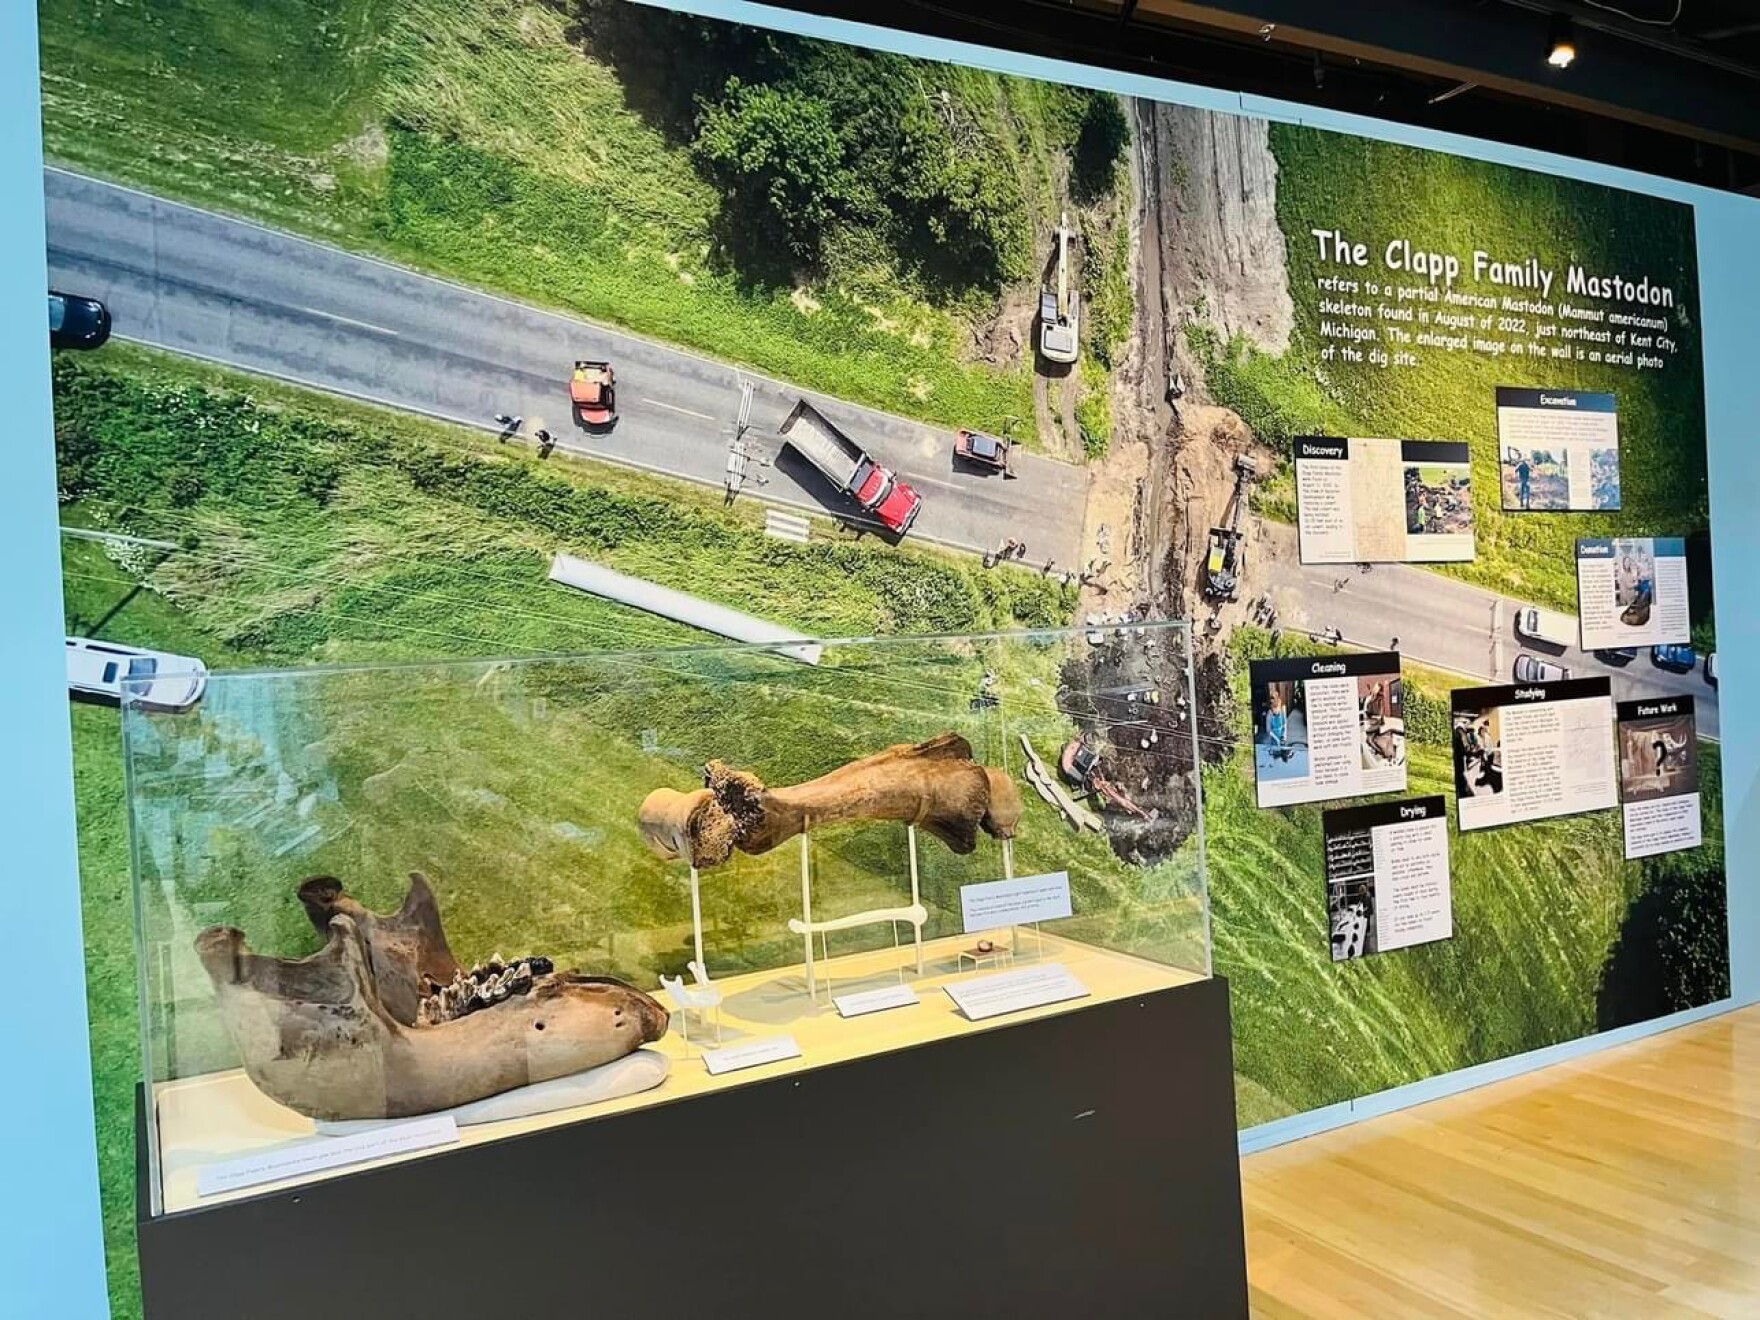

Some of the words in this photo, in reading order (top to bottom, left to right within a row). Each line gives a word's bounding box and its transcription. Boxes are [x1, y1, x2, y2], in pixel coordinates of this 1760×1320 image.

[1311, 229, 1368, 266] The
[1385, 239, 1459, 286] Clapp
[1473, 251, 1553, 299] Family
[1566, 264, 1673, 308] Mastodon
[1318, 275, 1359, 294] refers
[1365, 281, 1379, 294] to
[1384, 286, 1392, 296] a
[1398, 286, 1438, 302] partial
[1444, 290, 1497, 309] American
[1502, 296, 1554, 316] Mastodon
[1558, 303, 1604, 321] (Mammut
[1609, 312, 1668, 332] americanum)
[1319, 298, 1372, 317] skeleton
[1378, 303, 1413, 321] found
[1419, 307, 1429, 323] in
[1434, 311, 1475, 330] August
[1480, 315, 1493, 329] of
[1498, 317, 1530, 336] 2022,
[1535, 321, 1557, 339] just
[1561, 326, 1611, 344] northeast
[1615, 331, 1626, 345] of
[1630, 333, 1652, 349] Kent
[1656, 336, 1678, 354] City,
[1320, 321, 1380, 342] Michigan.
[1387, 327, 1412, 343] The
[1416, 331, 1468, 351] enlarged
[1473, 335, 1506, 356] image
[1510, 343, 1524, 354] on
[1528, 341, 1546, 357] the
[1551, 345, 1571, 358] wall
[1576, 346, 1585, 360] is
[1588, 350, 1601, 362] an
[1605, 352, 1634, 366] aerial
[1637, 353, 1664, 370] photo
[1321, 345, 1335, 361] of
[1341, 346, 1364, 363] the
[1368, 350, 1388, 368] dig
[1393, 351, 1420, 368] site.
[1540, 393, 1577, 406] Excavation
[1302, 444, 1344, 458] Discovery
[1311, 661, 1347, 674] Cleaning
[1514, 687, 1546, 700] Studying
[1637, 705, 1659, 716] Future
[1660, 703, 1677, 713] Work
[1400, 805, 1426, 819] Drying
